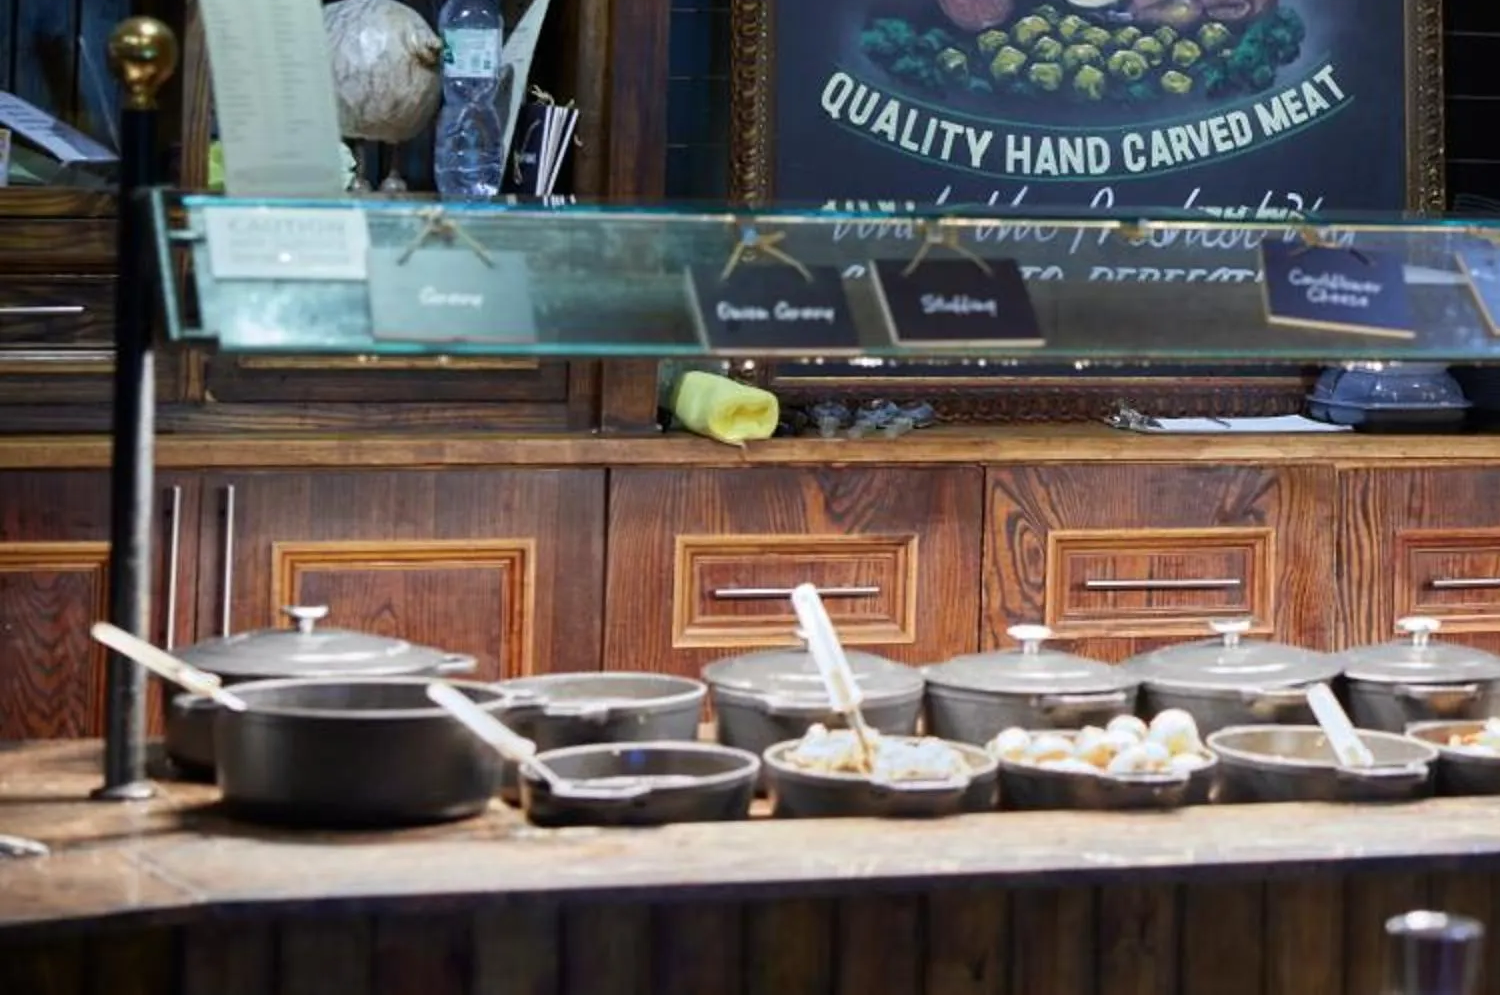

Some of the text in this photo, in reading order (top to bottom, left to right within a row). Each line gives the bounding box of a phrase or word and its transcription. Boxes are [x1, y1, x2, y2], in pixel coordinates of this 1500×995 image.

[820, 64, 1345, 175] QUALITY HAND CARVED MEAT
